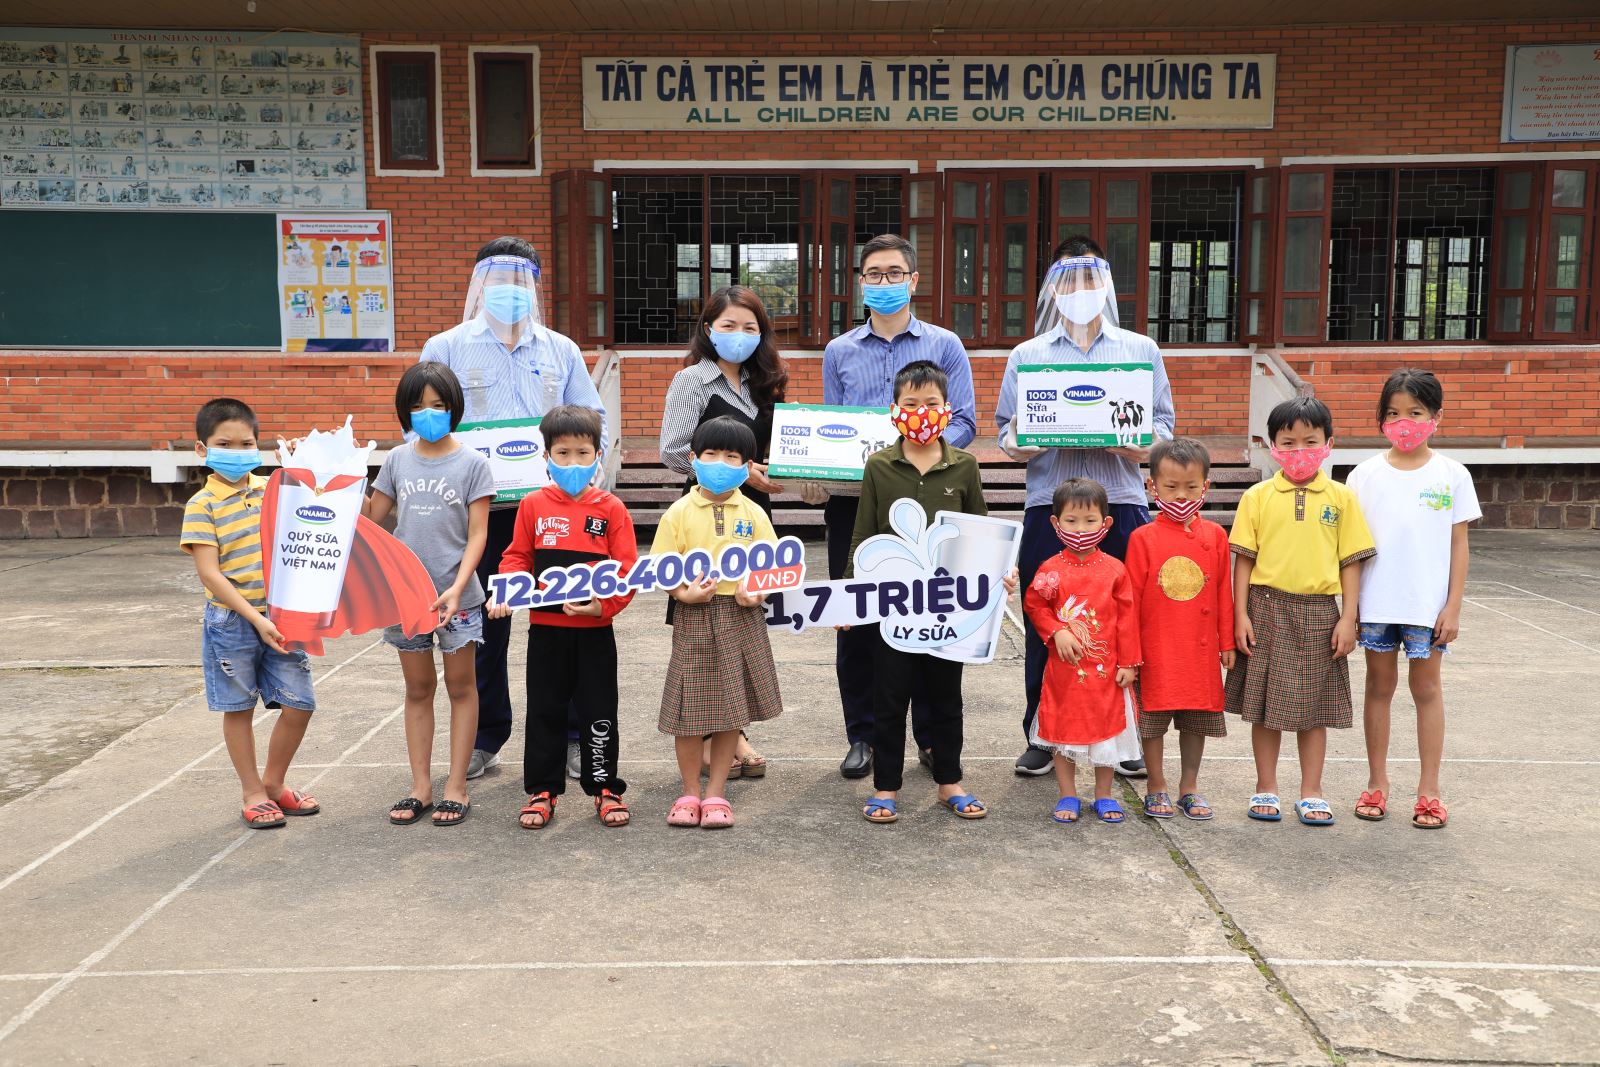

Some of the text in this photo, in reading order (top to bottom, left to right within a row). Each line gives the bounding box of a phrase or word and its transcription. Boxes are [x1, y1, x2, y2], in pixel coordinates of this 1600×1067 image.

[596, 58, 1262, 101] TẤT CẢ TRẺ EM LÀ TRẺ EM CỦA CHÚNG TA
[686, 105, 1177, 123] ALL CHILDREN ARE OUR CHILDREN.
[1028, 390, 1104, 400] 100% VINAMILK
[1026, 402, 1047, 412] Sữa
[1026, 412, 1057, 423] Tươi
[782, 427, 857, 437] 100% VINAMILK
[779, 436, 801, 446] Sữa
[498, 444, 537, 454] VINAMILK
[779, 446, 809, 456] Tươi
[400, 476, 461, 506] sharker
[298, 508, 335, 519] VINAMILK
[287, 530, 339, 544] QUỸ SỮA
[281, 543, 341, 558] VƯƠN CAO
[282, 556, 336, 571] VIỆT NAM
[491, 539, 801, 607] 12.226.400.000
[755, 570, 798, 589] VNĐ
[845, 567, 989, 623] TRIỆU
[893, 624, 958, 642] LY SỮA
